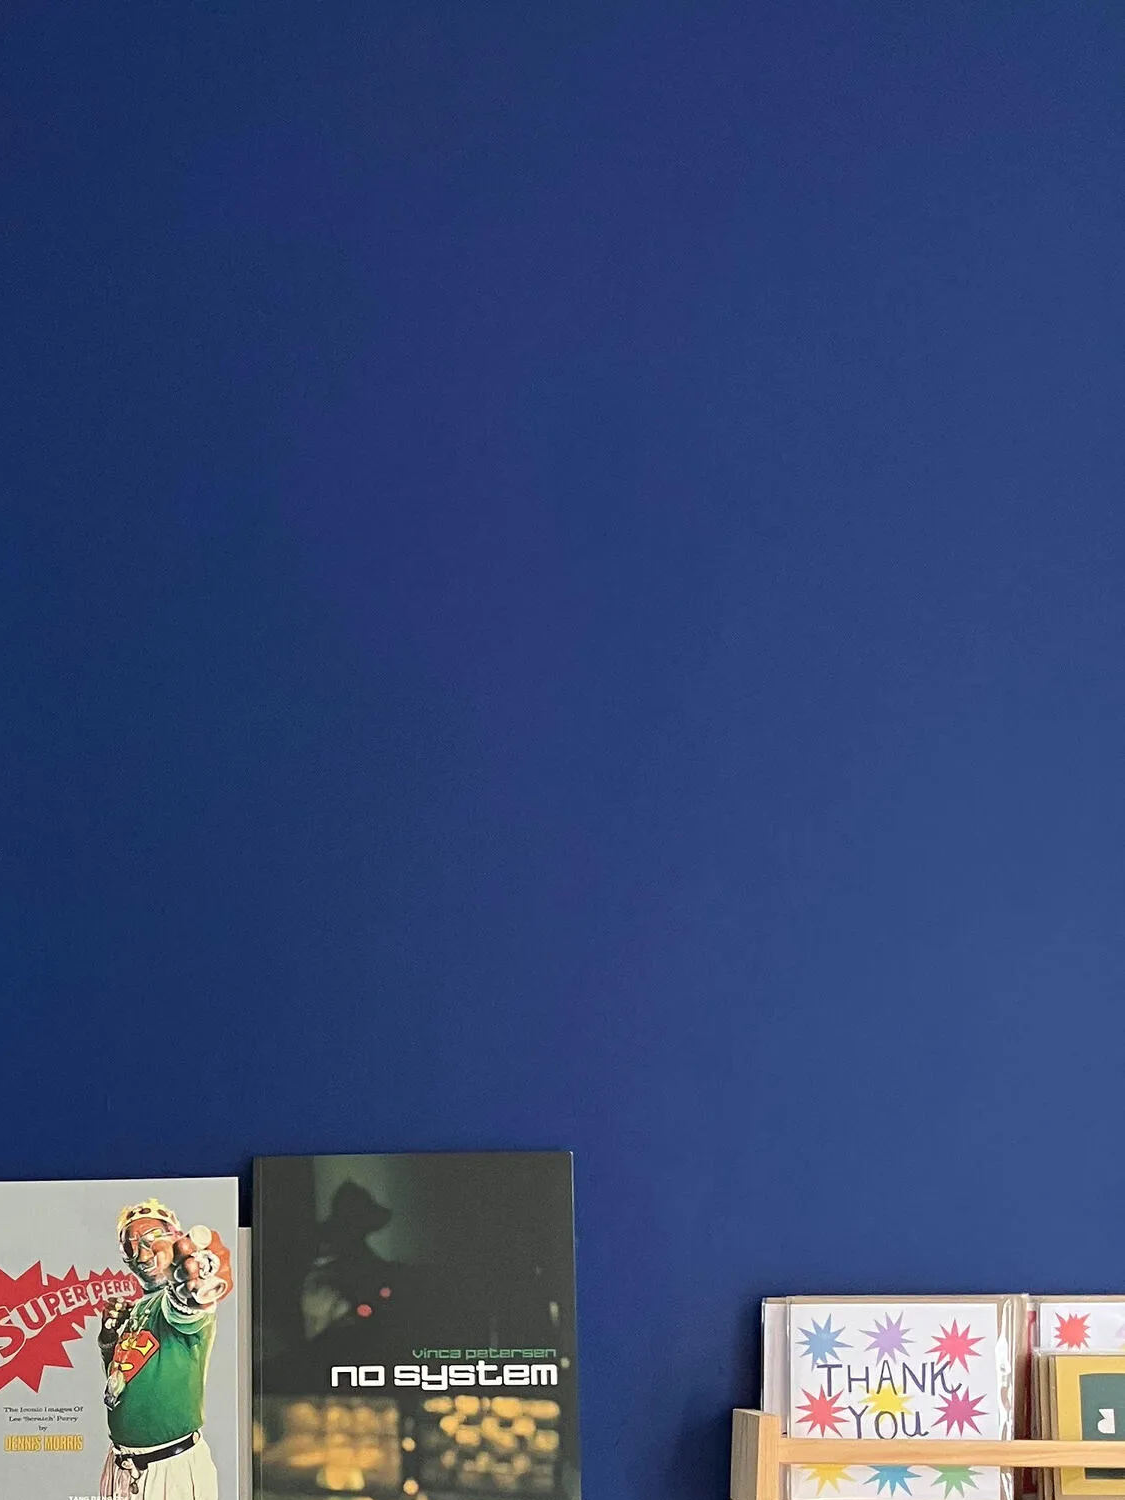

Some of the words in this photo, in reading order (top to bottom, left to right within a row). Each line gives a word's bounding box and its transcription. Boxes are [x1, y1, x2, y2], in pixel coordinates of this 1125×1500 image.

[412, 1347, 462, 1359] vinca
[465, 1347, 557, 1360] petersen
[330, 1364, 386, 1388] no
[393, 1363, 558, 1391] system
[816, 1360, 962, 1397] THANK
[4, 1435, 41, 1451] DENNIS
[44, 1435, 84, 1451] MORRIS
